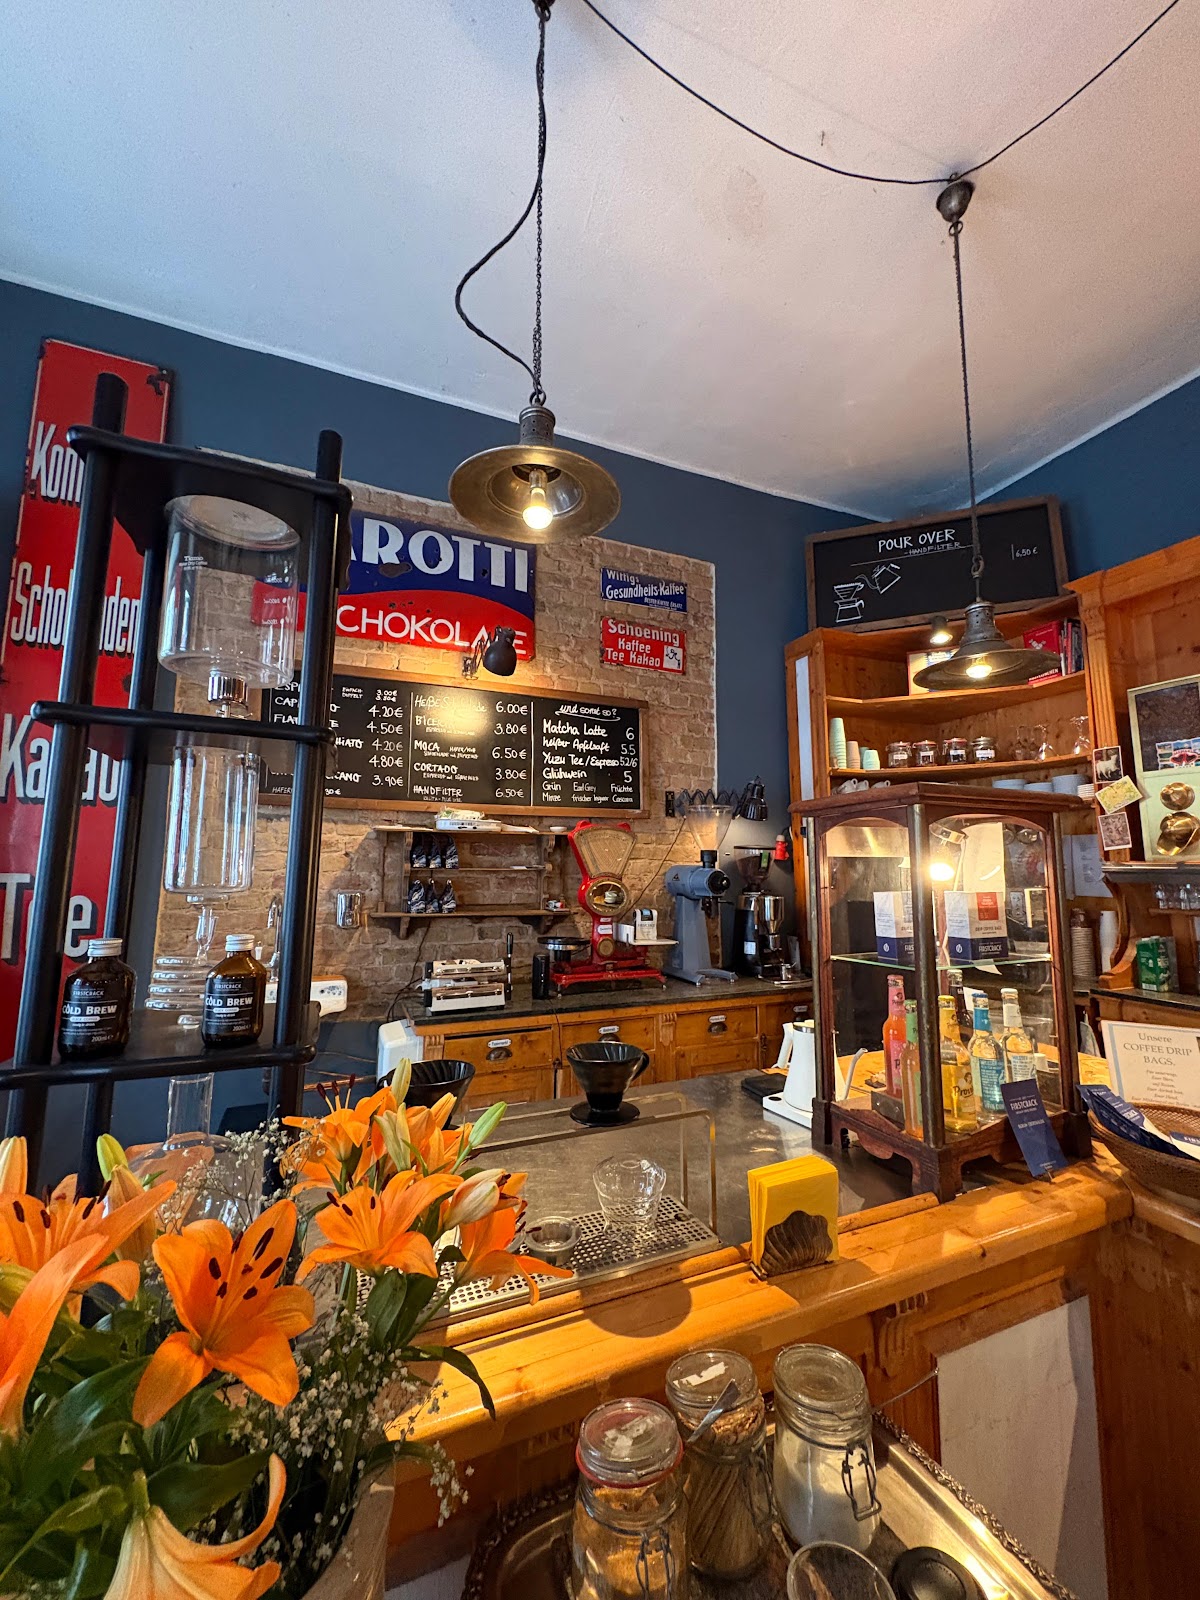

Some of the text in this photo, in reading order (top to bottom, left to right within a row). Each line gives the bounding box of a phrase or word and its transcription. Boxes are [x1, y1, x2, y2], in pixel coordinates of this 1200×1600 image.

[878, 529, 956, 553] POUR OVER
[351, 517, 528, 593] ROTTI
[336, 604, 528, 655] CHOKOLAE
[607, 618, 680, 647] Schoening
[618, 637, 651, 654] Kaffee
[605, 647, 661, 667] Tee Kakao
[368, 705, 404, 718] 4.20€
[495, 701, 528, 716] 6.00€
[559, 704, 579, 714] und
[366, 721, 403, 735] 4.50€
[493, 723, 528, 735] 3.80€
[542, 718, 609, 737] Matcha Latte
[625, 727, 635, 740] 6
[371, 740, 404, 752] 4.20€
[413, 739, 440, 751] MOCA
[620, 743, 636, 755] 5.5
[491, 746, 528, 759] 6.50€
[542, 751, 566, 765] Yuzu
[368, 755, 404, 768] 4.80€
[413, 763, 459, 774] CORTADO
[494, 767, 528, 781] 3.80€
[542, 767, 588, 780] Glühwein
[371, 775, 404, 787] 3.90€
[623, 770, 633, 783] 5
[494, 788, 525, 798] 6.50€
[542, 780, 562, 791] Grün
[610, 783, 634, 793] Früchte
[542, 792, 562, 802] Minze
[0, 873, 93, 959] Te
[205, 996, 254, 1007] COLD BREW
[62, 1003, 118, 1016] COLD BREW
[1137, 1032, 1172, 1043] Unsere
[1123, 1042, 1193, 1056] COFFEE DRIP
